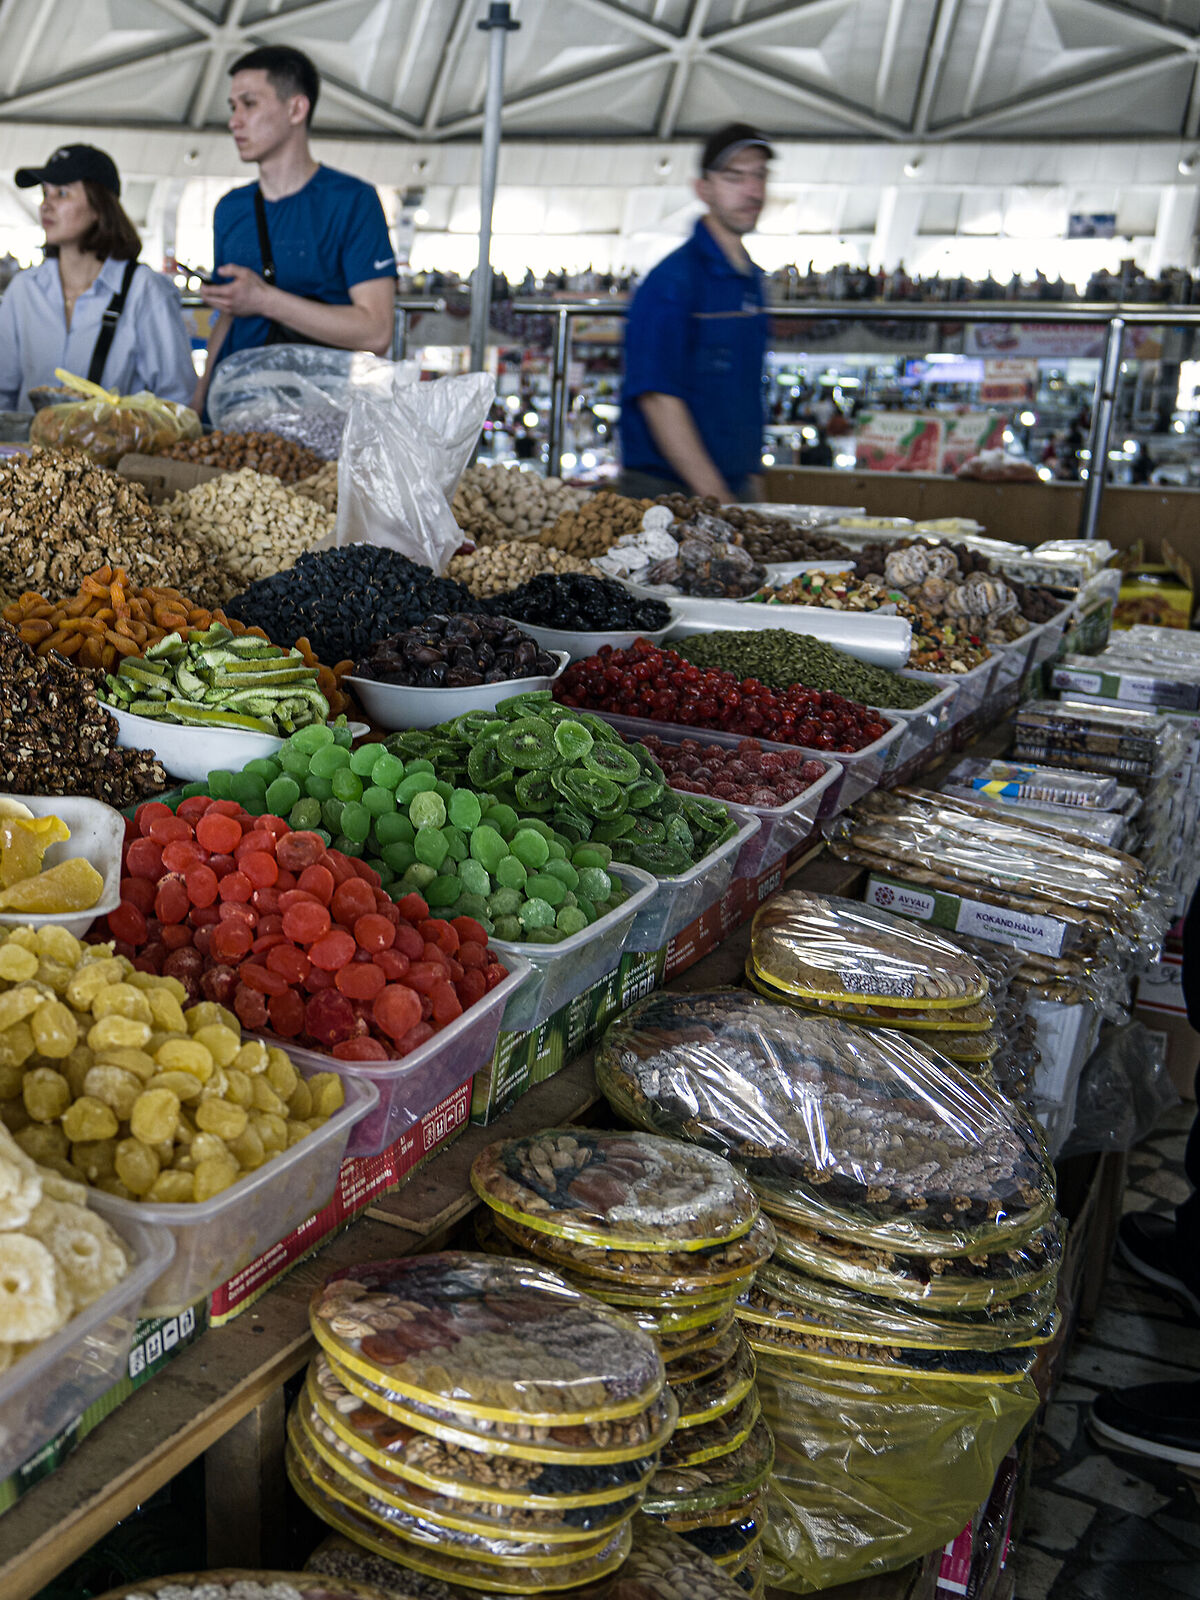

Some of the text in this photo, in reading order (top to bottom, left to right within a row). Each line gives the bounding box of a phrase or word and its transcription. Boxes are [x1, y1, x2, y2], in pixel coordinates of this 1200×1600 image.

[898, 895, 930, 909] AVVALI
[975, 912, 1044, 937] KOKAND HALVA
